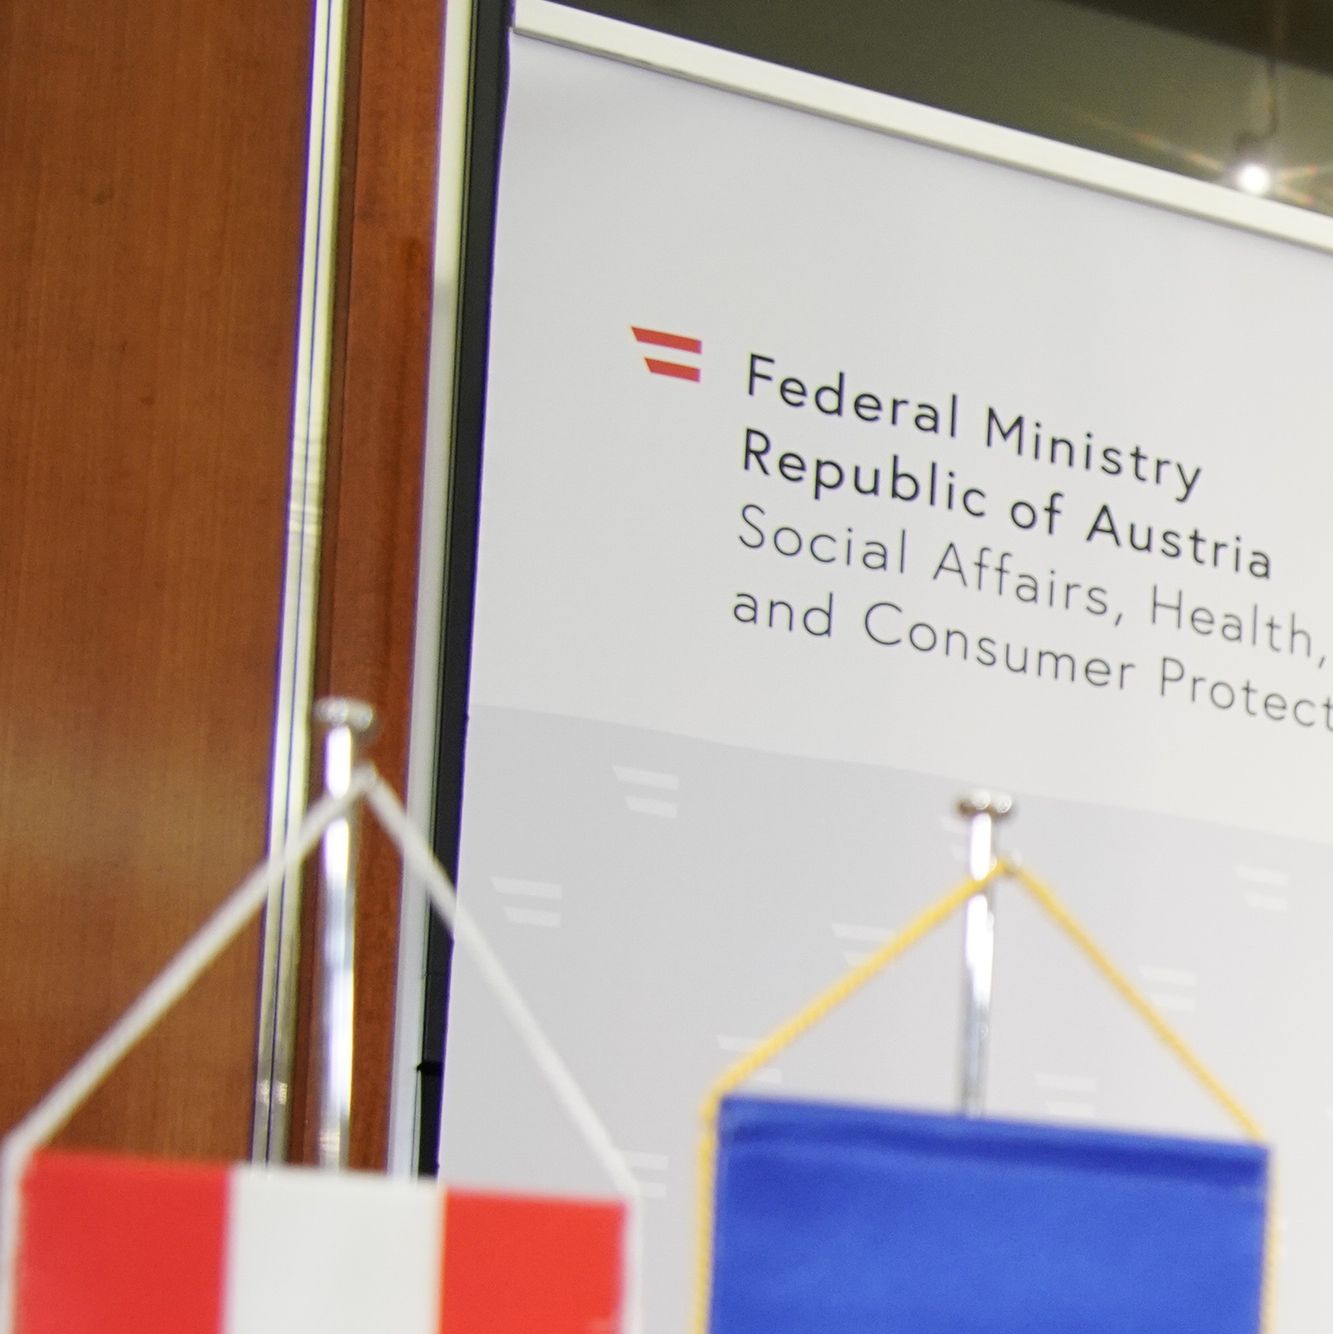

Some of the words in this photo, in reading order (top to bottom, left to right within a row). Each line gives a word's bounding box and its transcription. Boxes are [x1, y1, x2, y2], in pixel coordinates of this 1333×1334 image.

[743, 426, 987, 519] Republic
[1009, 490, 1065, 536] of
[1085, 502, 1272, 581] Austria
[747, 351, 959, 439] Federal
[985, 405, 1203, 505] Ministry
[732, 591, 834, 639] and
[863, 600, 1137, 691] Consumer
[737, 503, 907, 575] Social
[932, 541, 1123, 628] Affairs,
[1151, 583, 1326, 670] Health,
